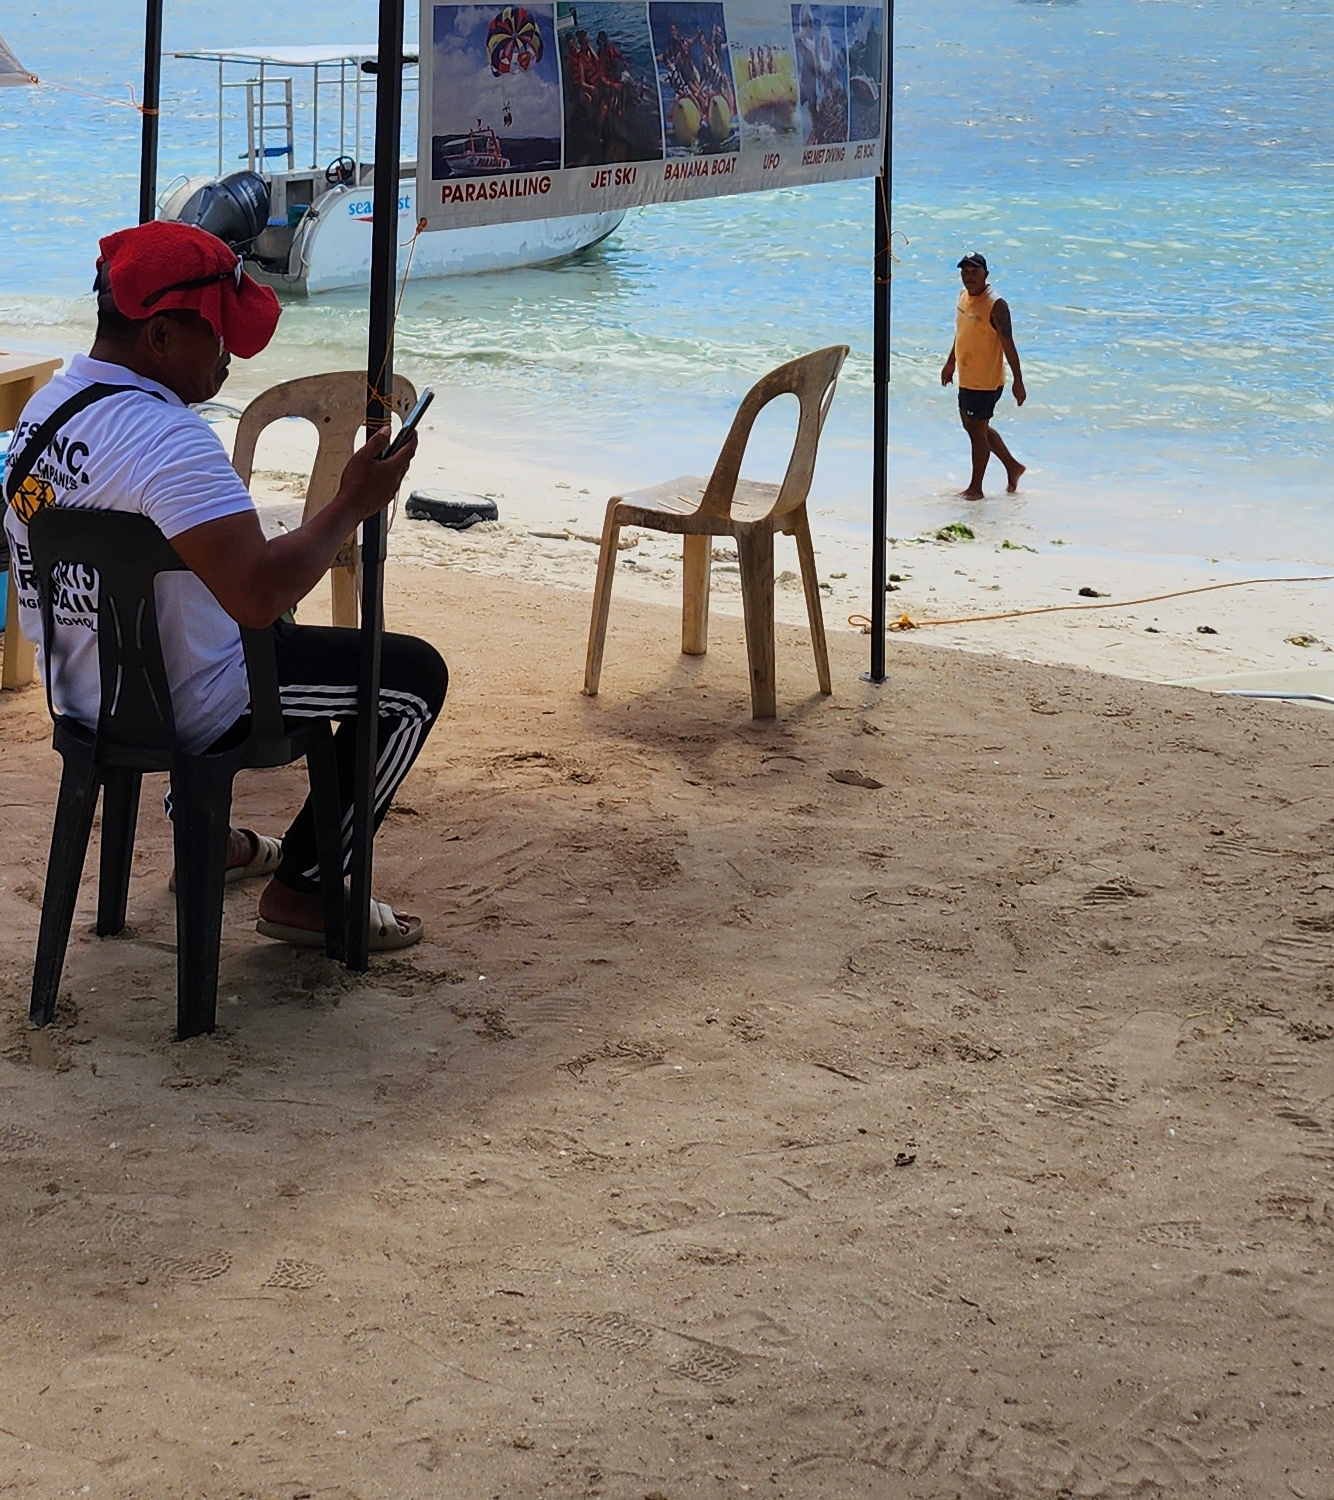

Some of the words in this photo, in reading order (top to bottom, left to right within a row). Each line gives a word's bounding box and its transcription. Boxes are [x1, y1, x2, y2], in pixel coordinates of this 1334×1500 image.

[664, 159, 708, 181] BANANA
[711, 157, 737, 176] BOAT
[763, 153, 780, 170] UFO
[591, 169, 612, 188] JET
[613, 167, 637, 186] SKI
[441, 176, 551, 204] PARASAILING
